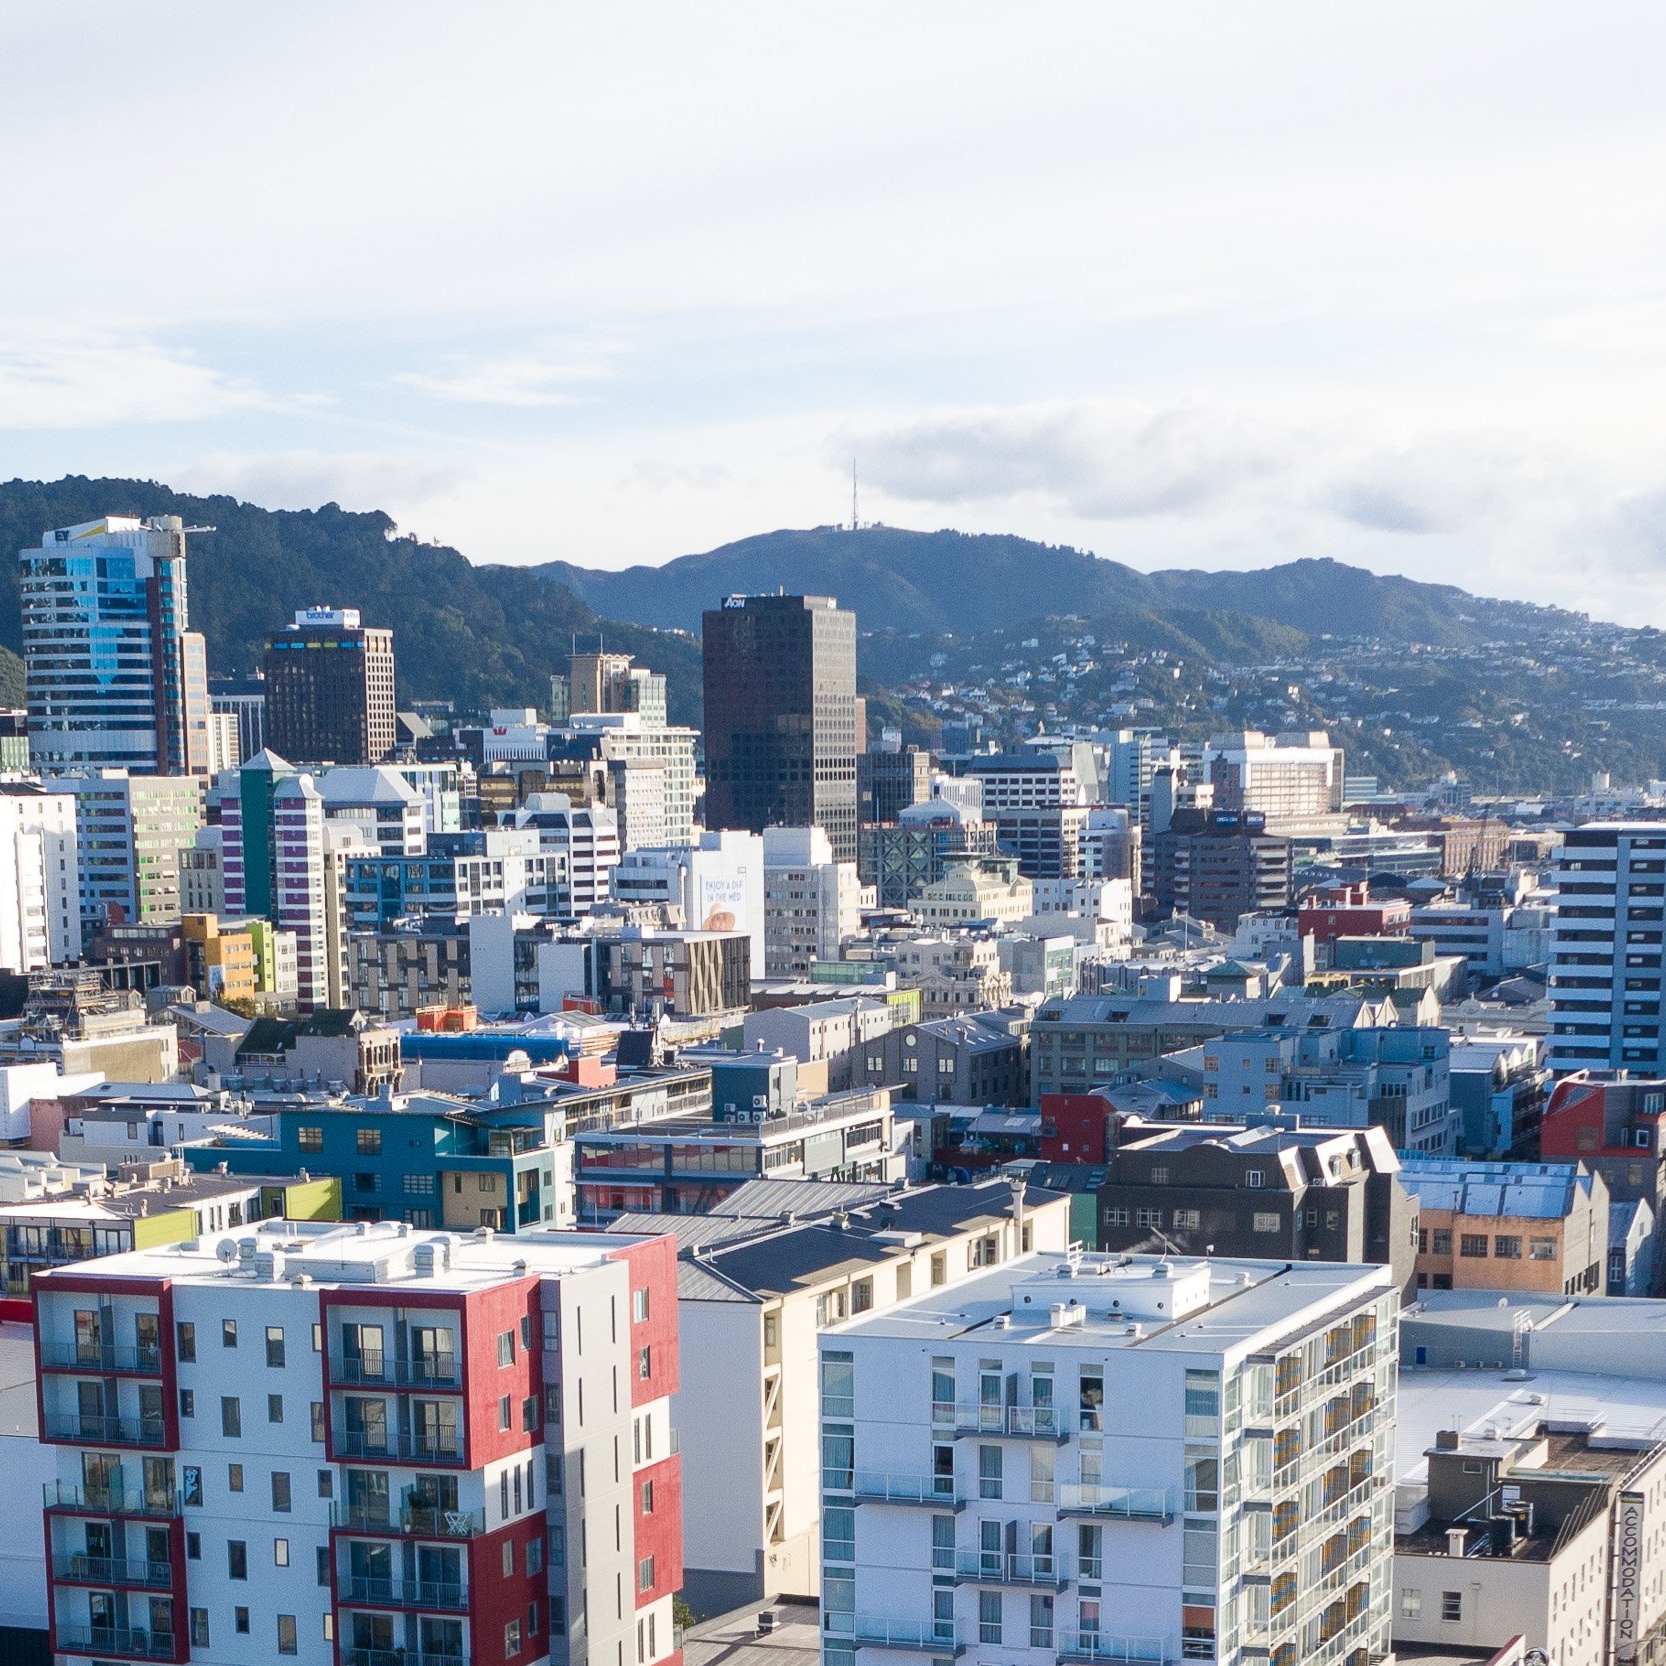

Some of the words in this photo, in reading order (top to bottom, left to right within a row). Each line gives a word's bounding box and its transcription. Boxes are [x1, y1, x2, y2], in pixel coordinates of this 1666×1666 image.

[54, 530, 70, 542] EY
[306, 611, 334, 619] brother
[705, 880, 724, 892] ENJOY
[732, 880, 743, 890] DIP
[1620, 1506, 1638, 1639] ACCOMMODATION
